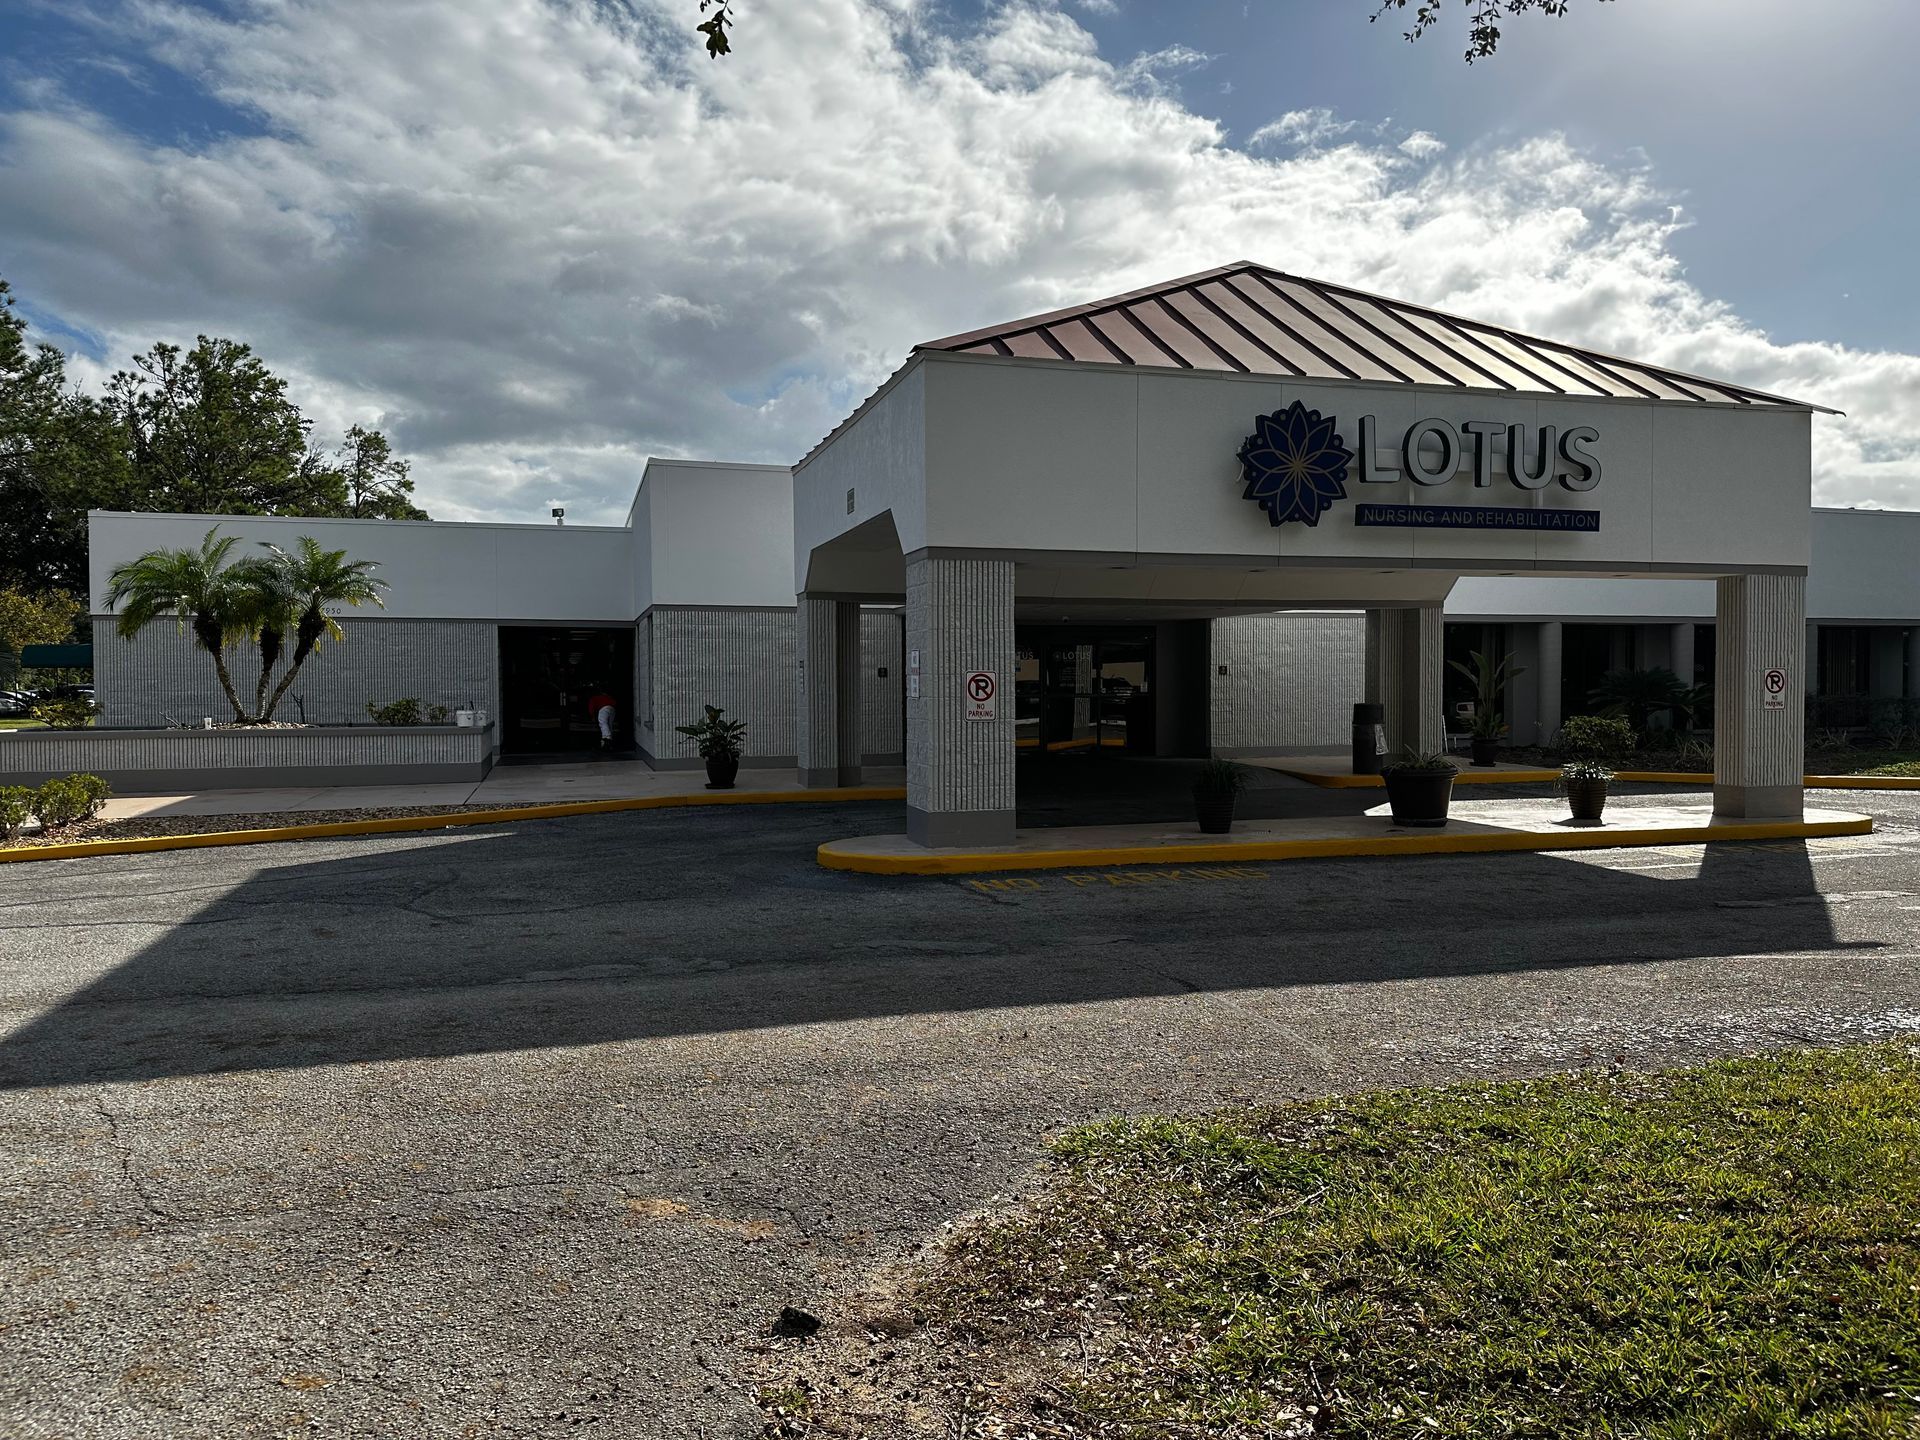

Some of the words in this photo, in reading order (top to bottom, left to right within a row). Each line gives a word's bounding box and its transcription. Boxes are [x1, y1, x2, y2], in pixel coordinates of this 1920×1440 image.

[1358, 414, 1603, 493] LOTUS
[1364, 508, 1435, 525] NURSING
[1441, 511, 1473, 525] AND
[1476, 511, 1597, 528] REHABILITATION
[1062, 651, 1091, 660] LOTUS
[968, 710, 994, 718] PARKING
[968, 877, 1042, 893] NO
[1063, 867, 1268, 887] PARKING
